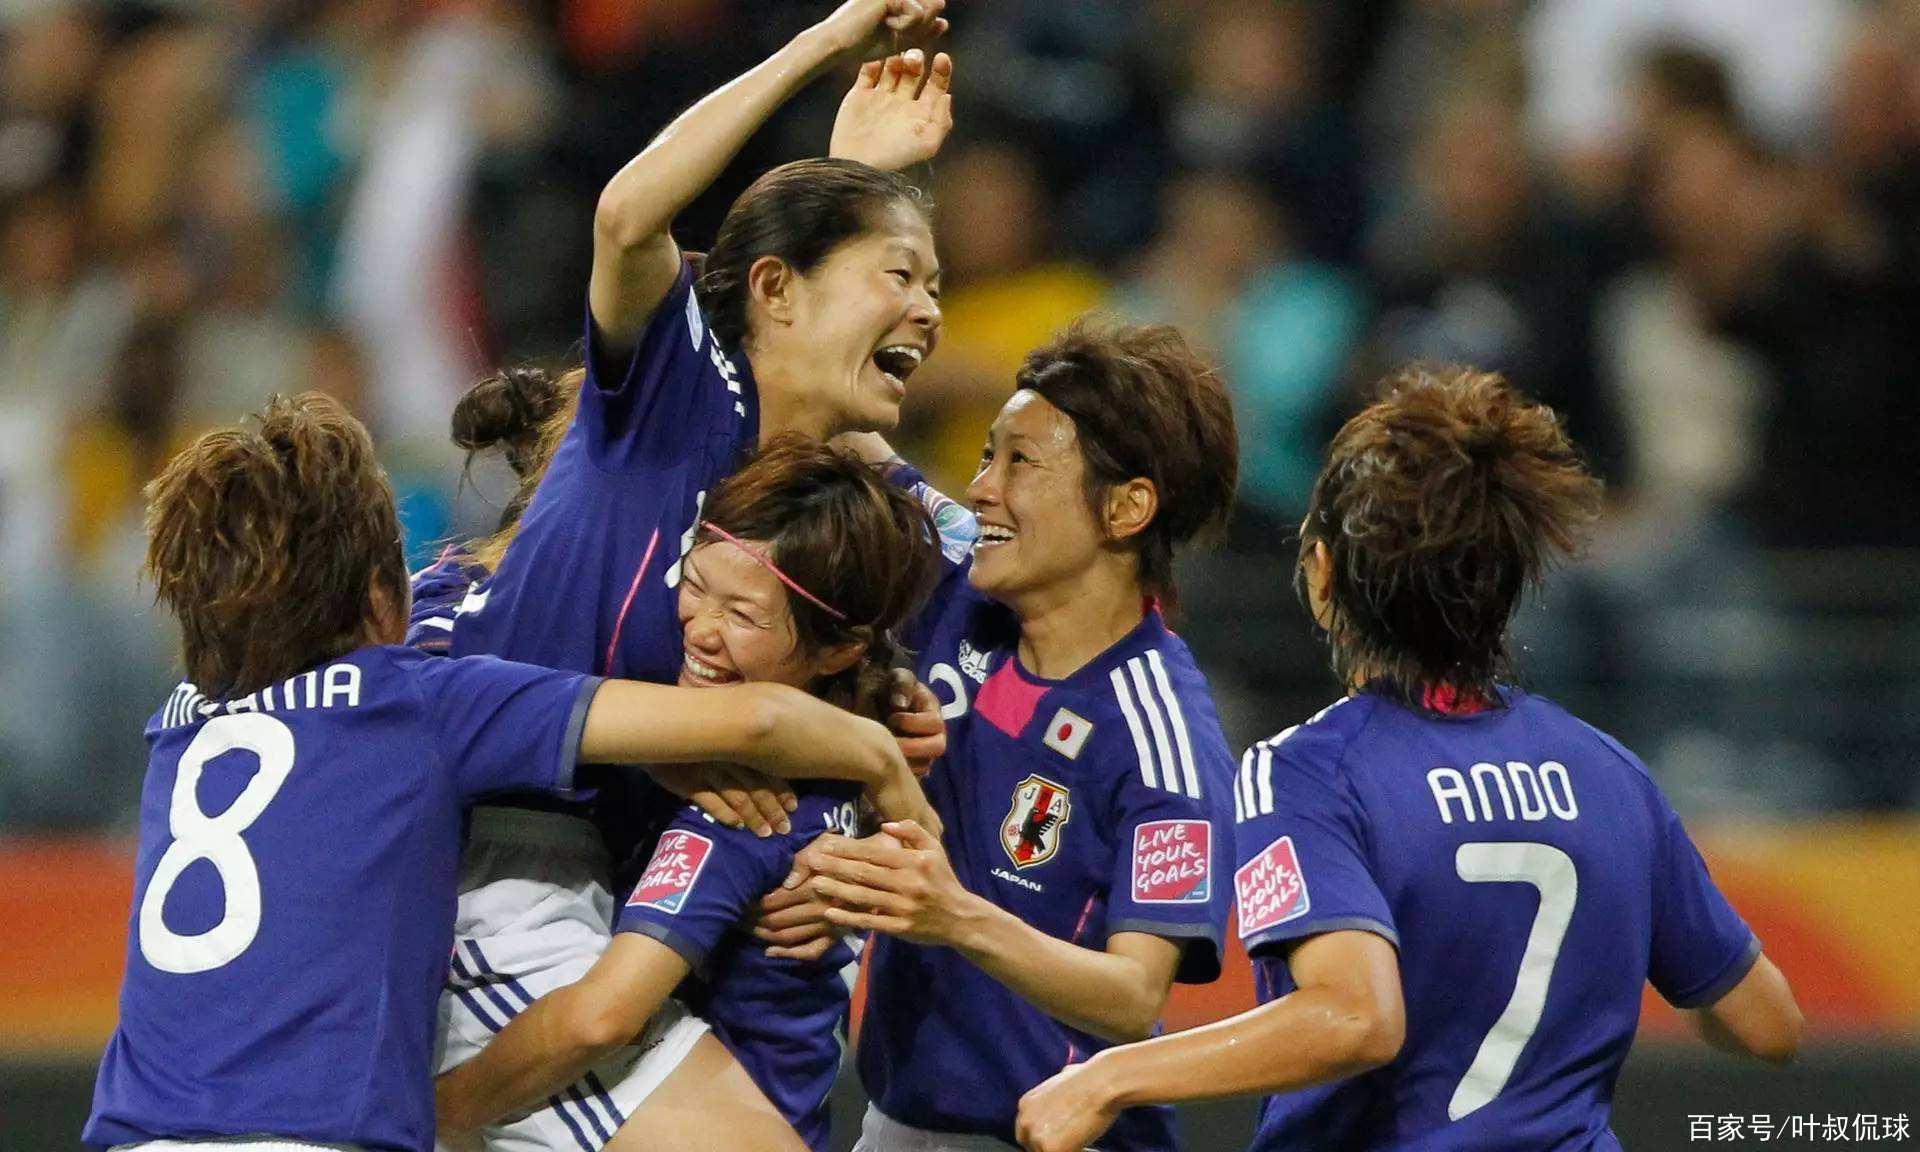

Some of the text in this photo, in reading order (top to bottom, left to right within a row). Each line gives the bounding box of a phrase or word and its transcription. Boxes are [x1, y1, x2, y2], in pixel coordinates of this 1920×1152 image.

[1426, 760, 1579, 824] ANDO
[139, 712, 296, 974] 8
[652, 834, 689, 857] IVE
[1136, 841, 1201, 872] YOUR
[1138, 823, 1187, 851] LIVE
[645, 852, 691, 875] OUR
[990, 867, 1042, 892] JAPAN
[1136, 858, 1206, 893] GOALS
[1241, 852, 1275, 898] LIVE
[1241, 864, 1292, 914] YOUR
[1244, 873, 1301, 928] GOALS
[1447, 842, 1578, 1122] 7
